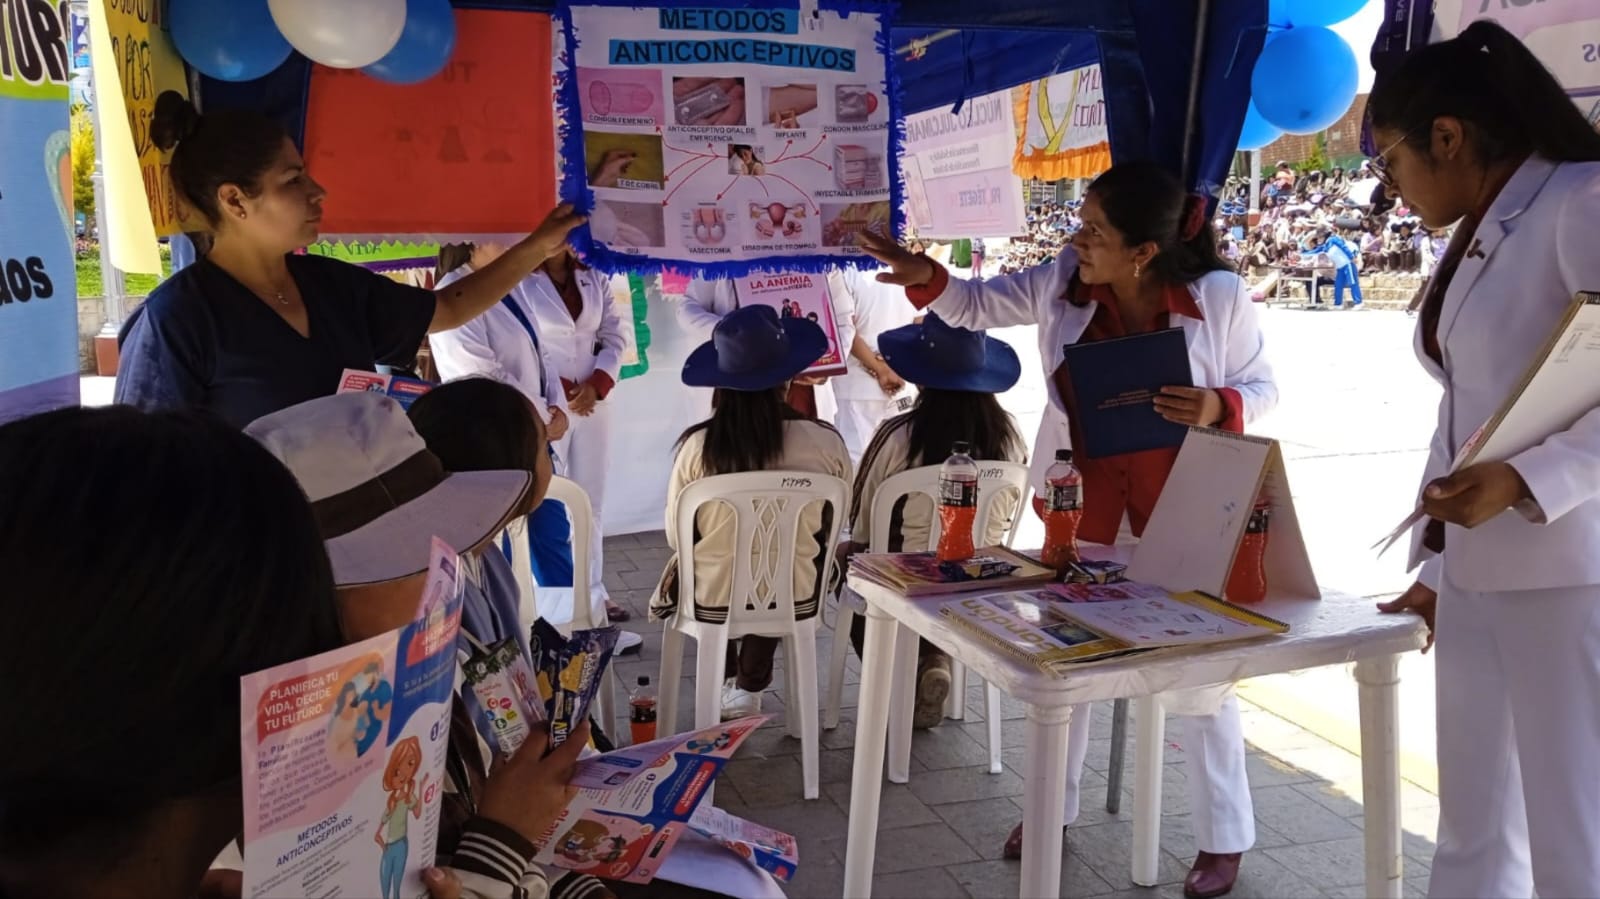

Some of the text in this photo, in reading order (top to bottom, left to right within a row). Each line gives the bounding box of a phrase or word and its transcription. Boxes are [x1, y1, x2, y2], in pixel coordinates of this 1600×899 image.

[660, 8, 786, 33] METODOS
[614, 40, 856, 71] ANTICONCEPTIVOS
[668, 126, 725, 135] ANTICONCEPTIVO
[750, 275, 811, 290] LA ANEMIA
[270, 671, 338, 701] PLANIFICA TU
[296, 686, 331, 707] DECIDE
[264, 717, 280, 731] TU
[297, 813, 338, 843] MÉTODOS
[276, 816, 353, 867] ANTICONCEPTIVOS
